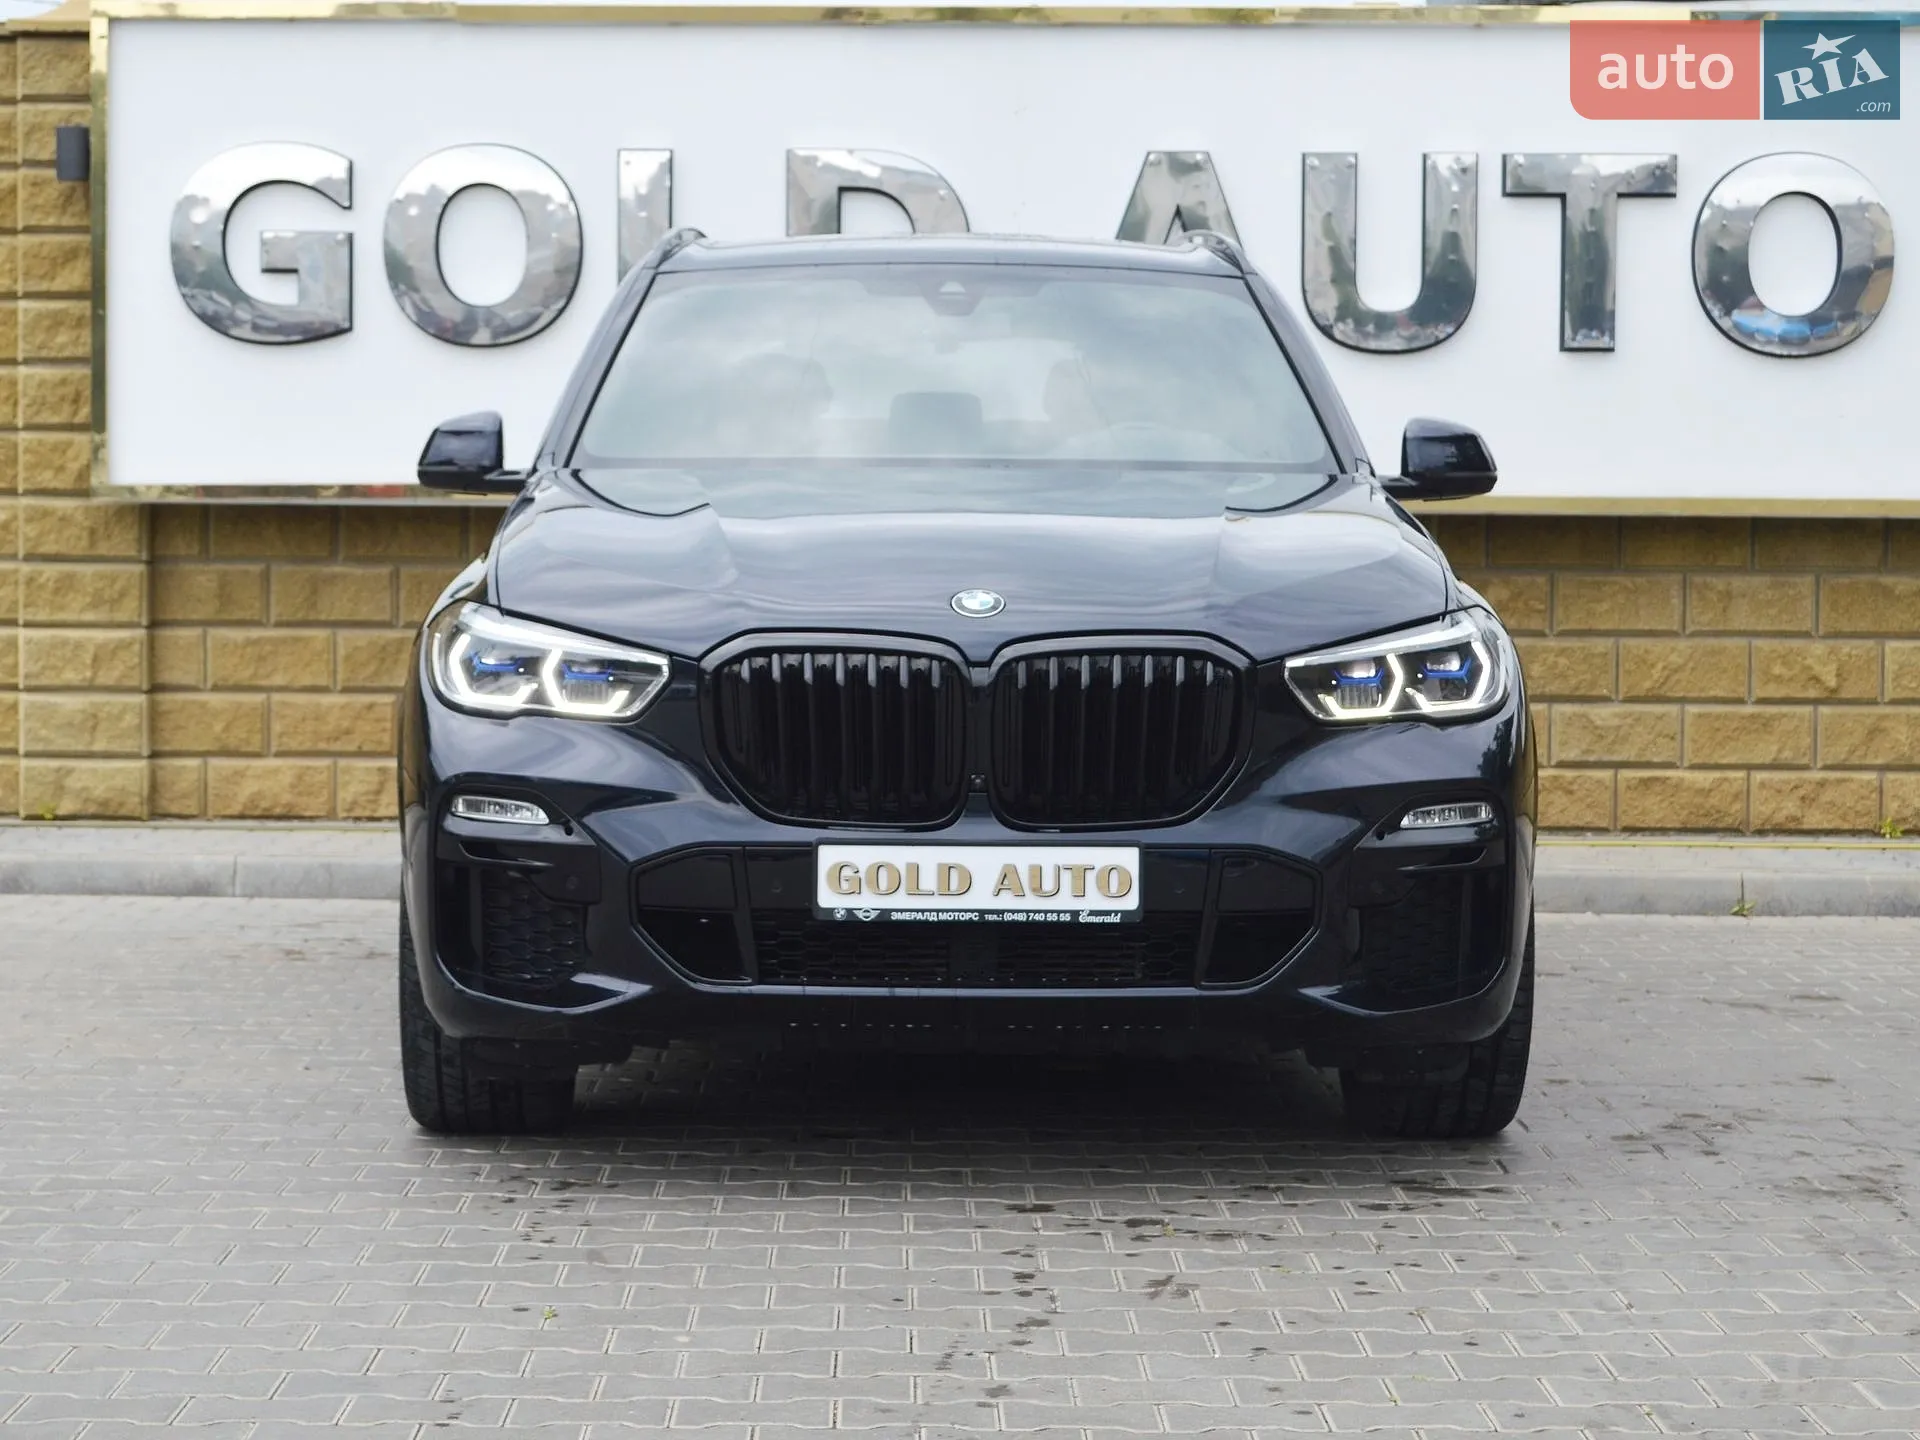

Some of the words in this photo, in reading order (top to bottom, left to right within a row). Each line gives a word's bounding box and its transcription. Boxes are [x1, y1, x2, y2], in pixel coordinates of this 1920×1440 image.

[826, 861, 973, 897] GOLD
[992, 863, 1133, 899] AUTO
[890, 911, 938, 921] ЭМЕРАЛД
[938, 911, 980, 921] МОТОРС
[1003, 911, 1028, 922] (048)
[1028, 912, 1045, 921] 740
[1046, 912, 1058, 921] 55
[1059, 912, 1071, 921] 55
[1078, 909, 1121, 923] Emerald
